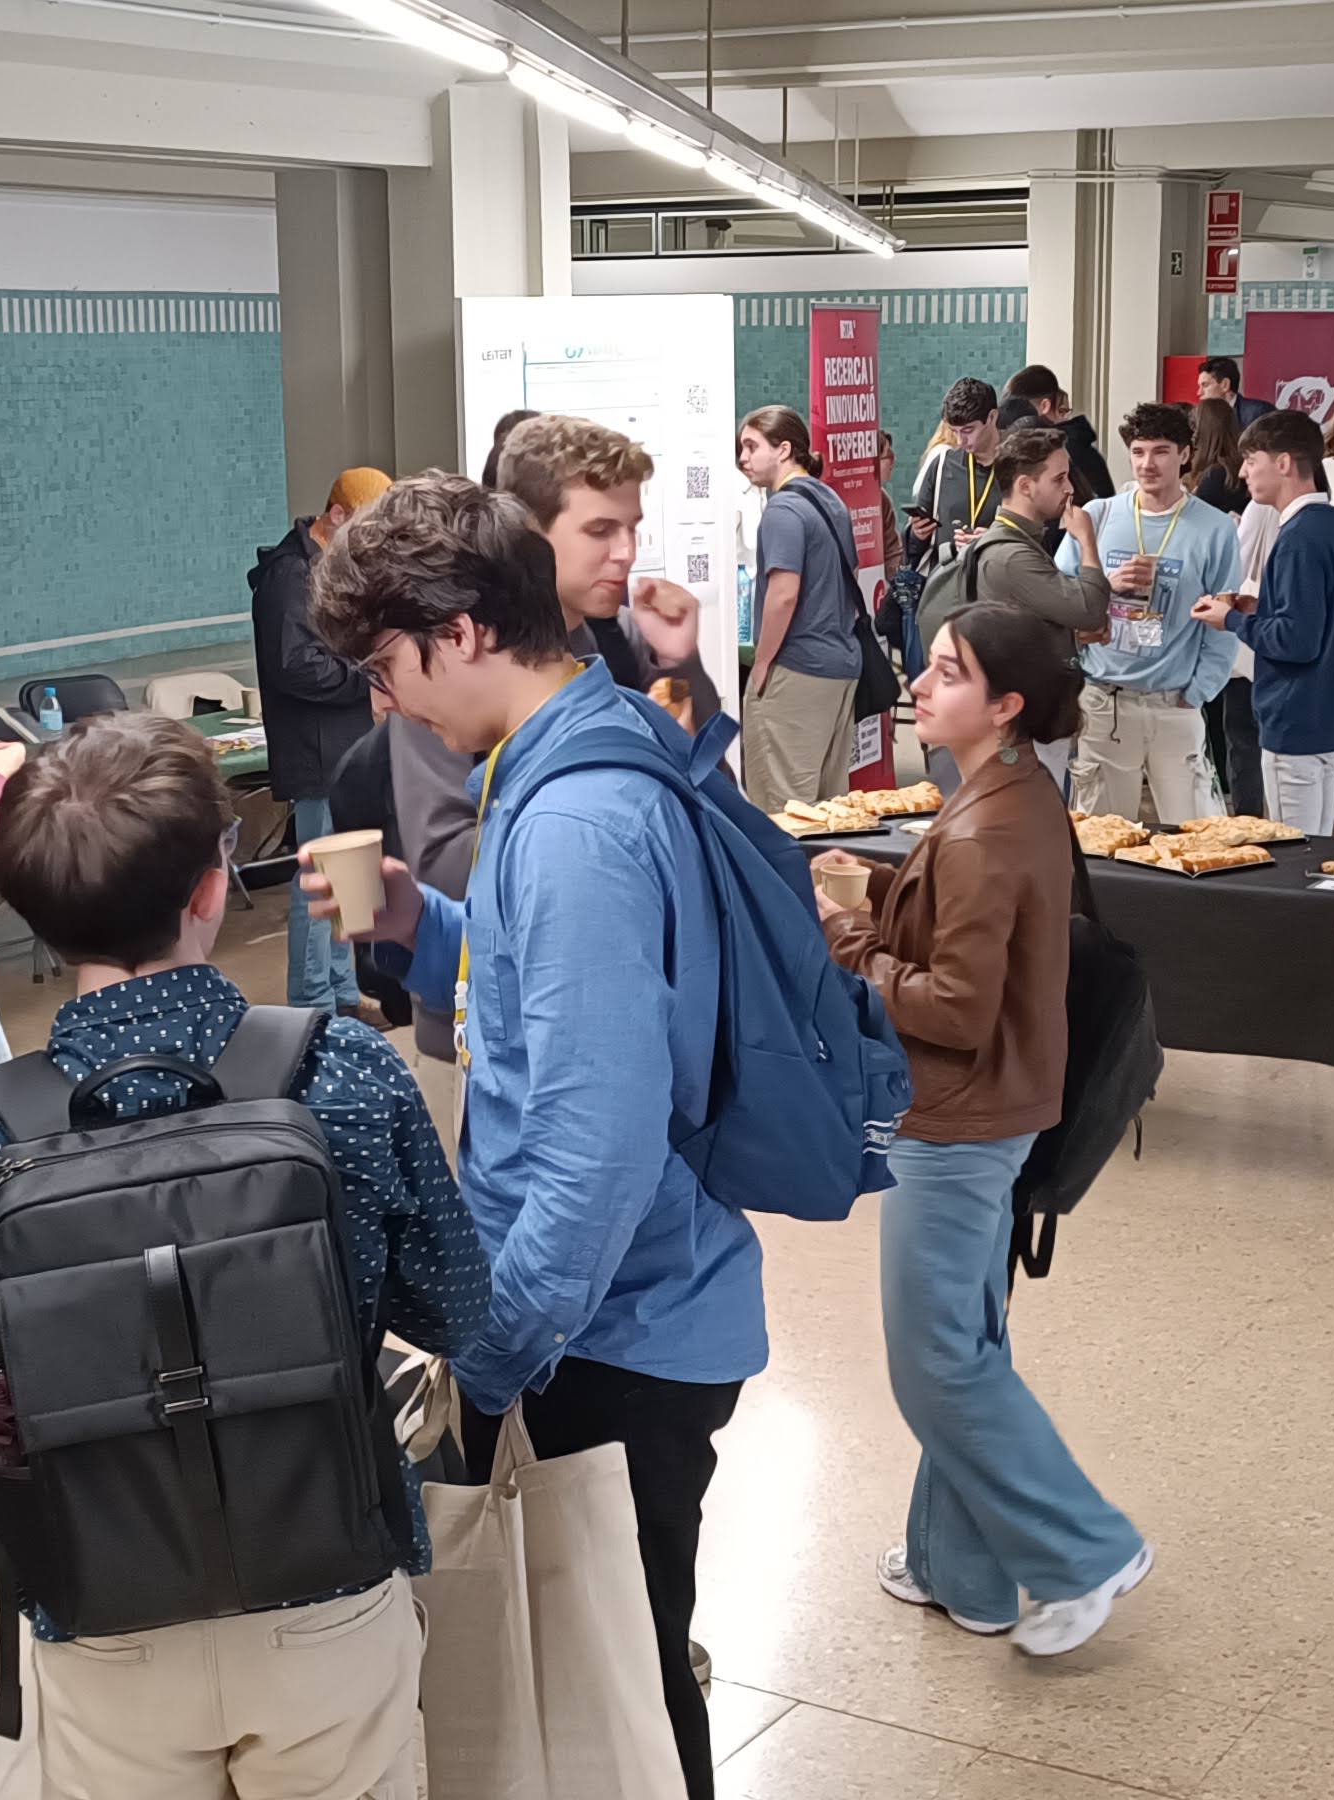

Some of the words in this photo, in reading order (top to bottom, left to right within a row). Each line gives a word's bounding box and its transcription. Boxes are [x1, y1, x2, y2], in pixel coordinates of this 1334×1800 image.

[824, 356, 868, 387] RECERCA
[869, 356, 874, 386] I
[826, 386, 876, 425] INNOVACIÓ
[826, 430, 878, 463] T'ESPEREN
